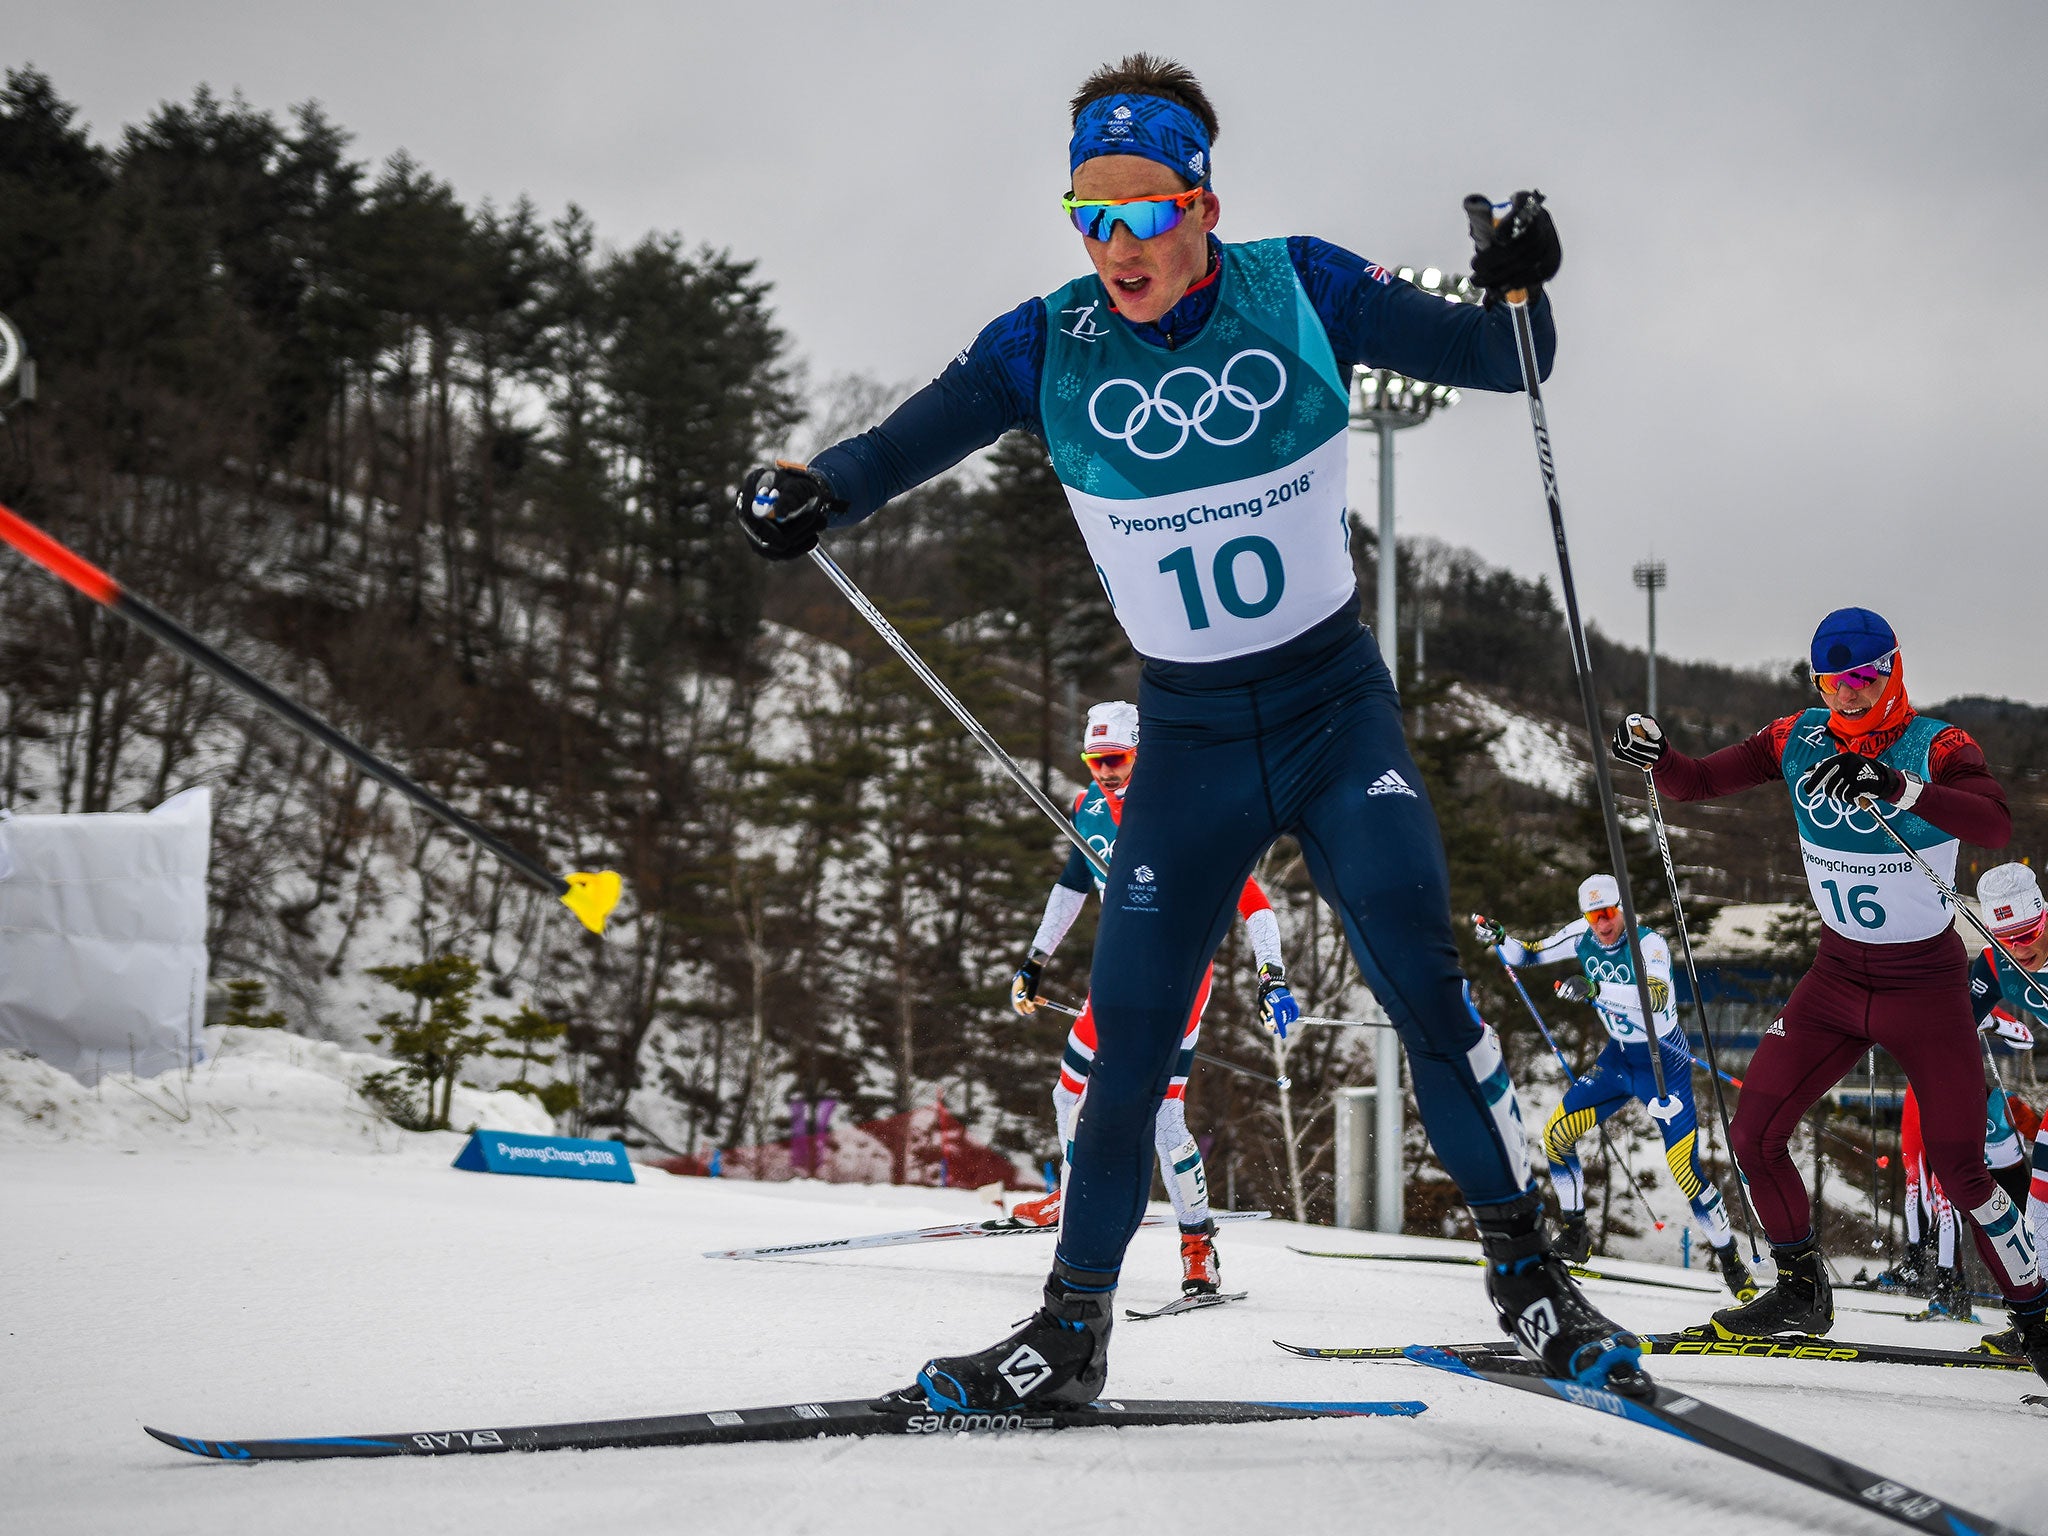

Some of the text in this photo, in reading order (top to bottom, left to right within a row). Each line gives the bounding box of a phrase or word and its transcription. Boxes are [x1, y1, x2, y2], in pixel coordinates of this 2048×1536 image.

[1108, 473, 1311, 536] PyeongChang 2018
[1158, 535, 1286, 631] 10
[1856, 772, 1880, 782] adidas
[1367, 785, 1418, 798] adidas
[1878, 861, 1914, 875] 2018
[1820, 879, 1887, 930] 16
[497, 1142, 618, 1167] PyeongChang 2018
[754, 1239, 850, 1255] MADSHUS
[1669, 1341, 1860, 1361] FISCHER
